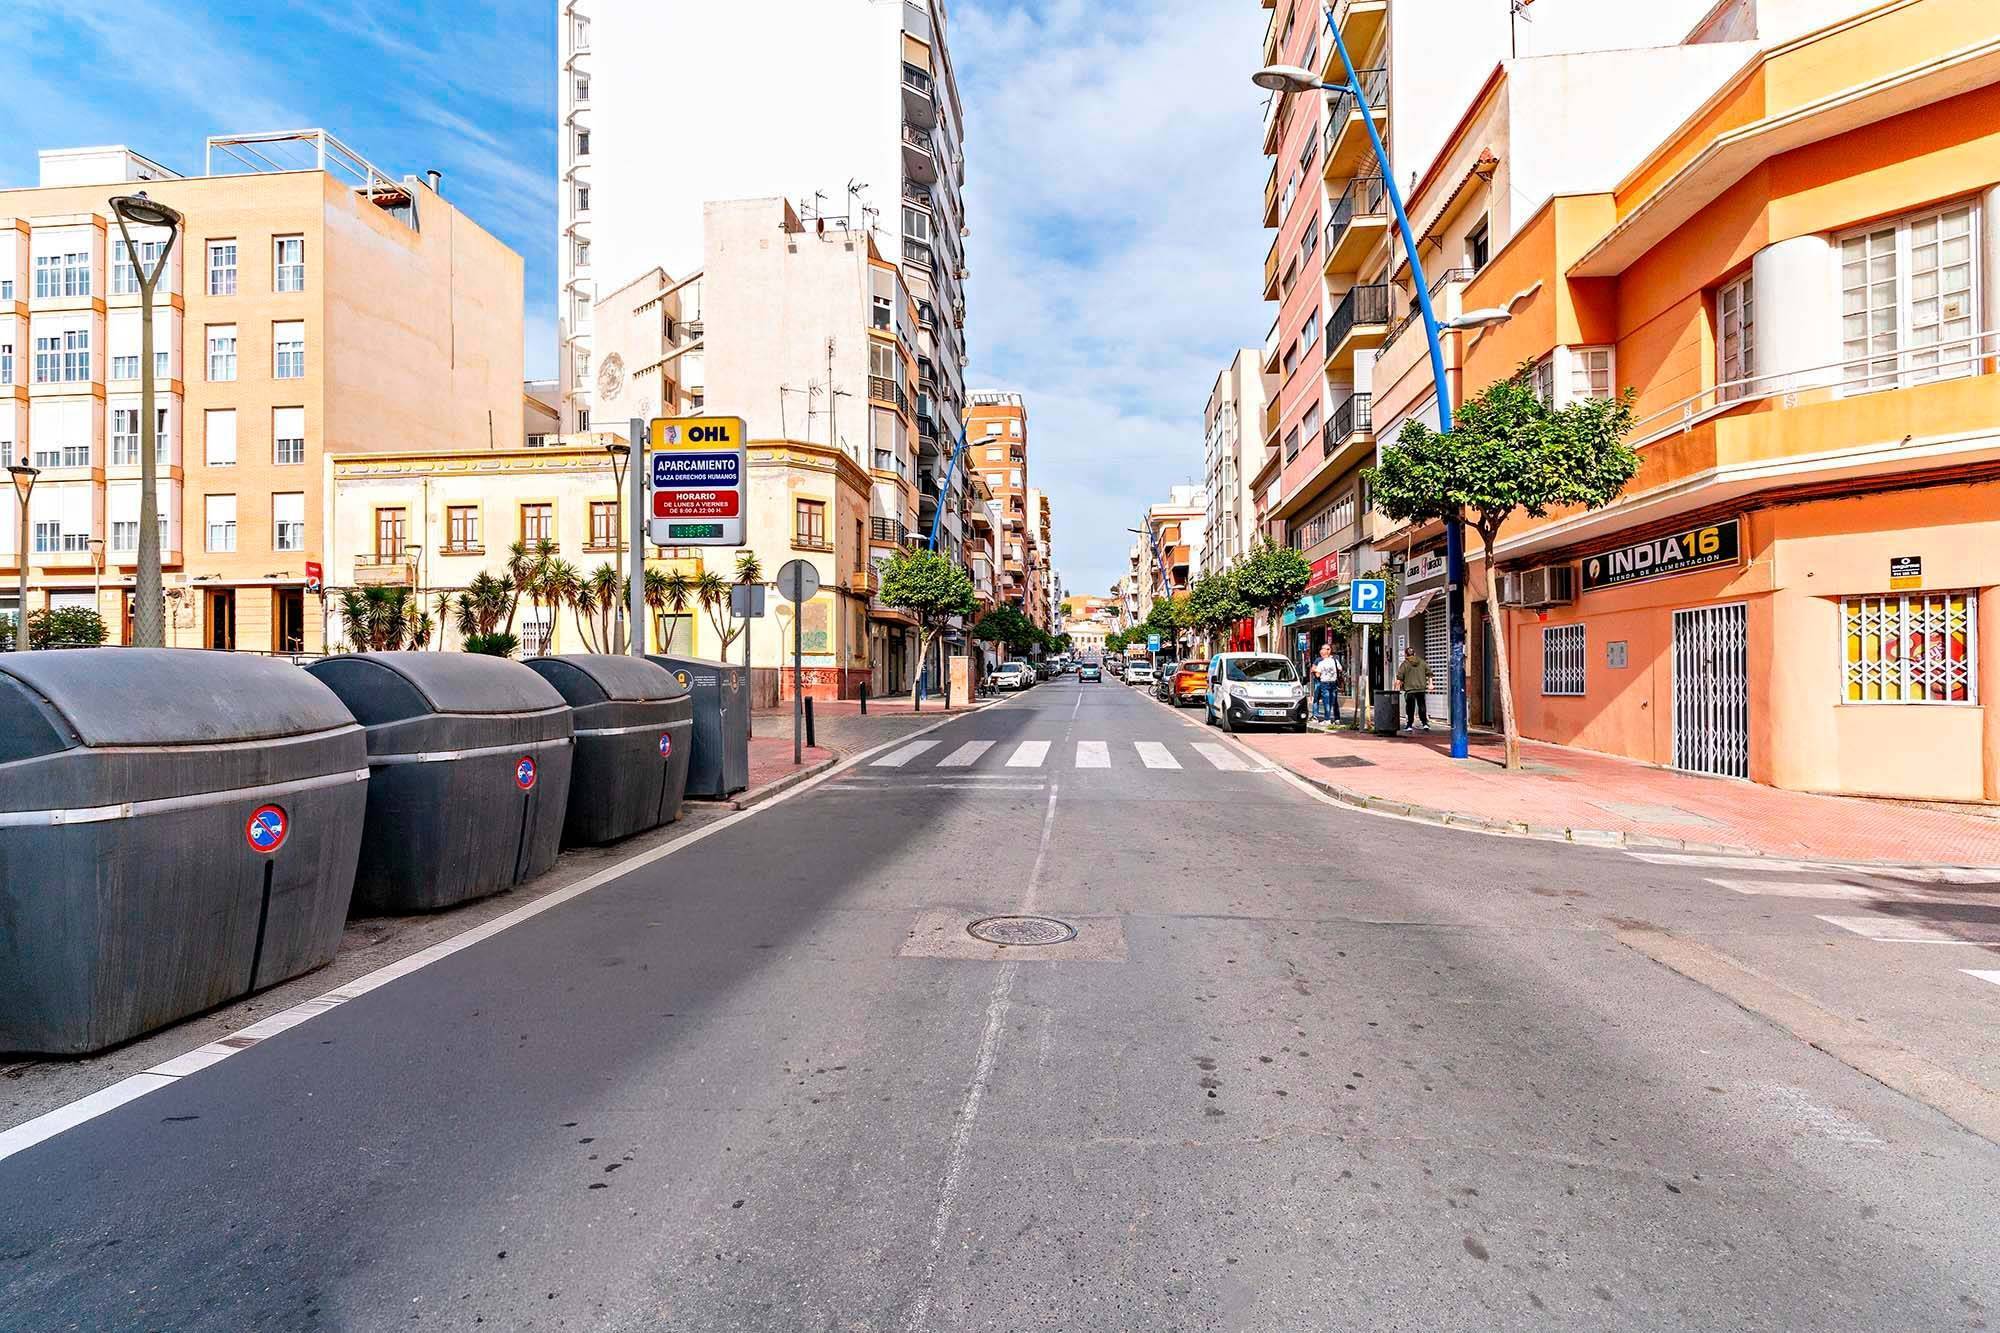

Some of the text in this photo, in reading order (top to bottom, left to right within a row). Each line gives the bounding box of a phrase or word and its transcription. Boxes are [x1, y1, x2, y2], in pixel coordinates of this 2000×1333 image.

[688, 426, 730, 442] OHL
[657, 459, 736, 471] APARCAMIENTO
[1609, 553, 1720, 583] TIENDA DE ALIMENTACIÓN
[1357, 583, 1379, 609] P
[1371, 600, 1383, 609] Z1
